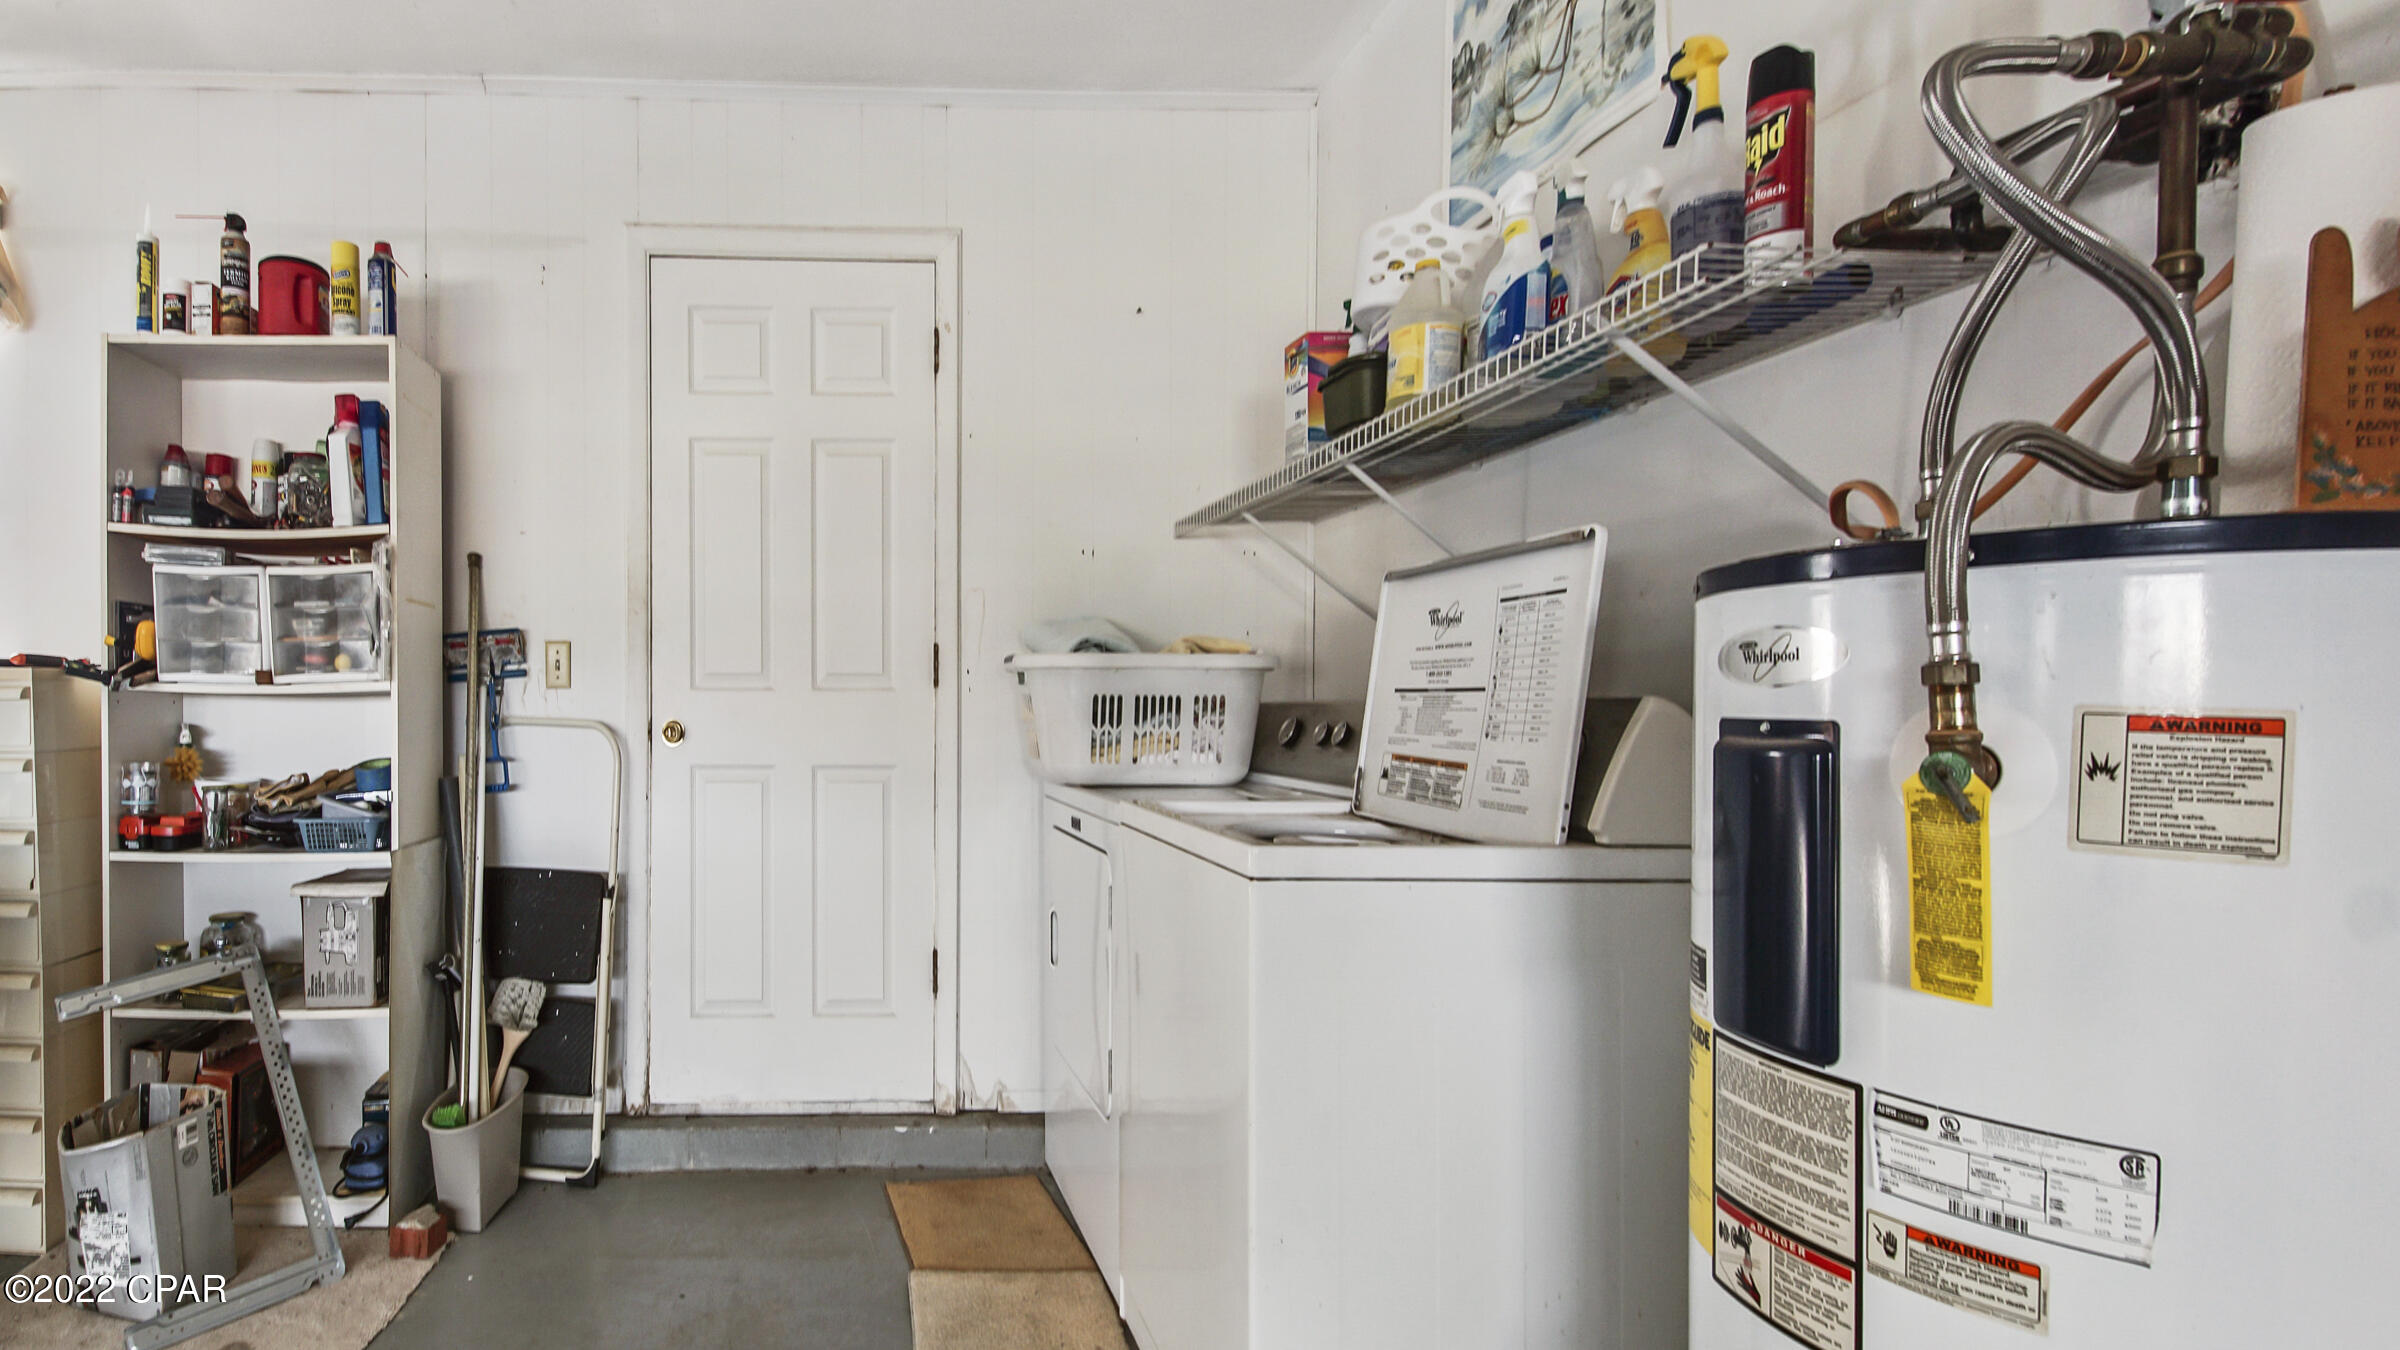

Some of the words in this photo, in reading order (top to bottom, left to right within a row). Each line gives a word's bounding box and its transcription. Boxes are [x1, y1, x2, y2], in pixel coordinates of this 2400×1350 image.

[1755, 183, 1786, 200] Roach
[1429, 611, 1463, 628] Whirlpool
[1742, 646, 1800, 665] Whirlpool
[2167, 719, 2263, 734] WARNING
[2229, 747, 2266, 755] pressure
[2196, 789, 2235, 797] company
[2244, 799, 2274, 807] service
[2160, 812, 2179, 820] plug
[1756, 1224, 1806, 1259] DANGER
[1936, 1236, 2021, 1272] WARNING
